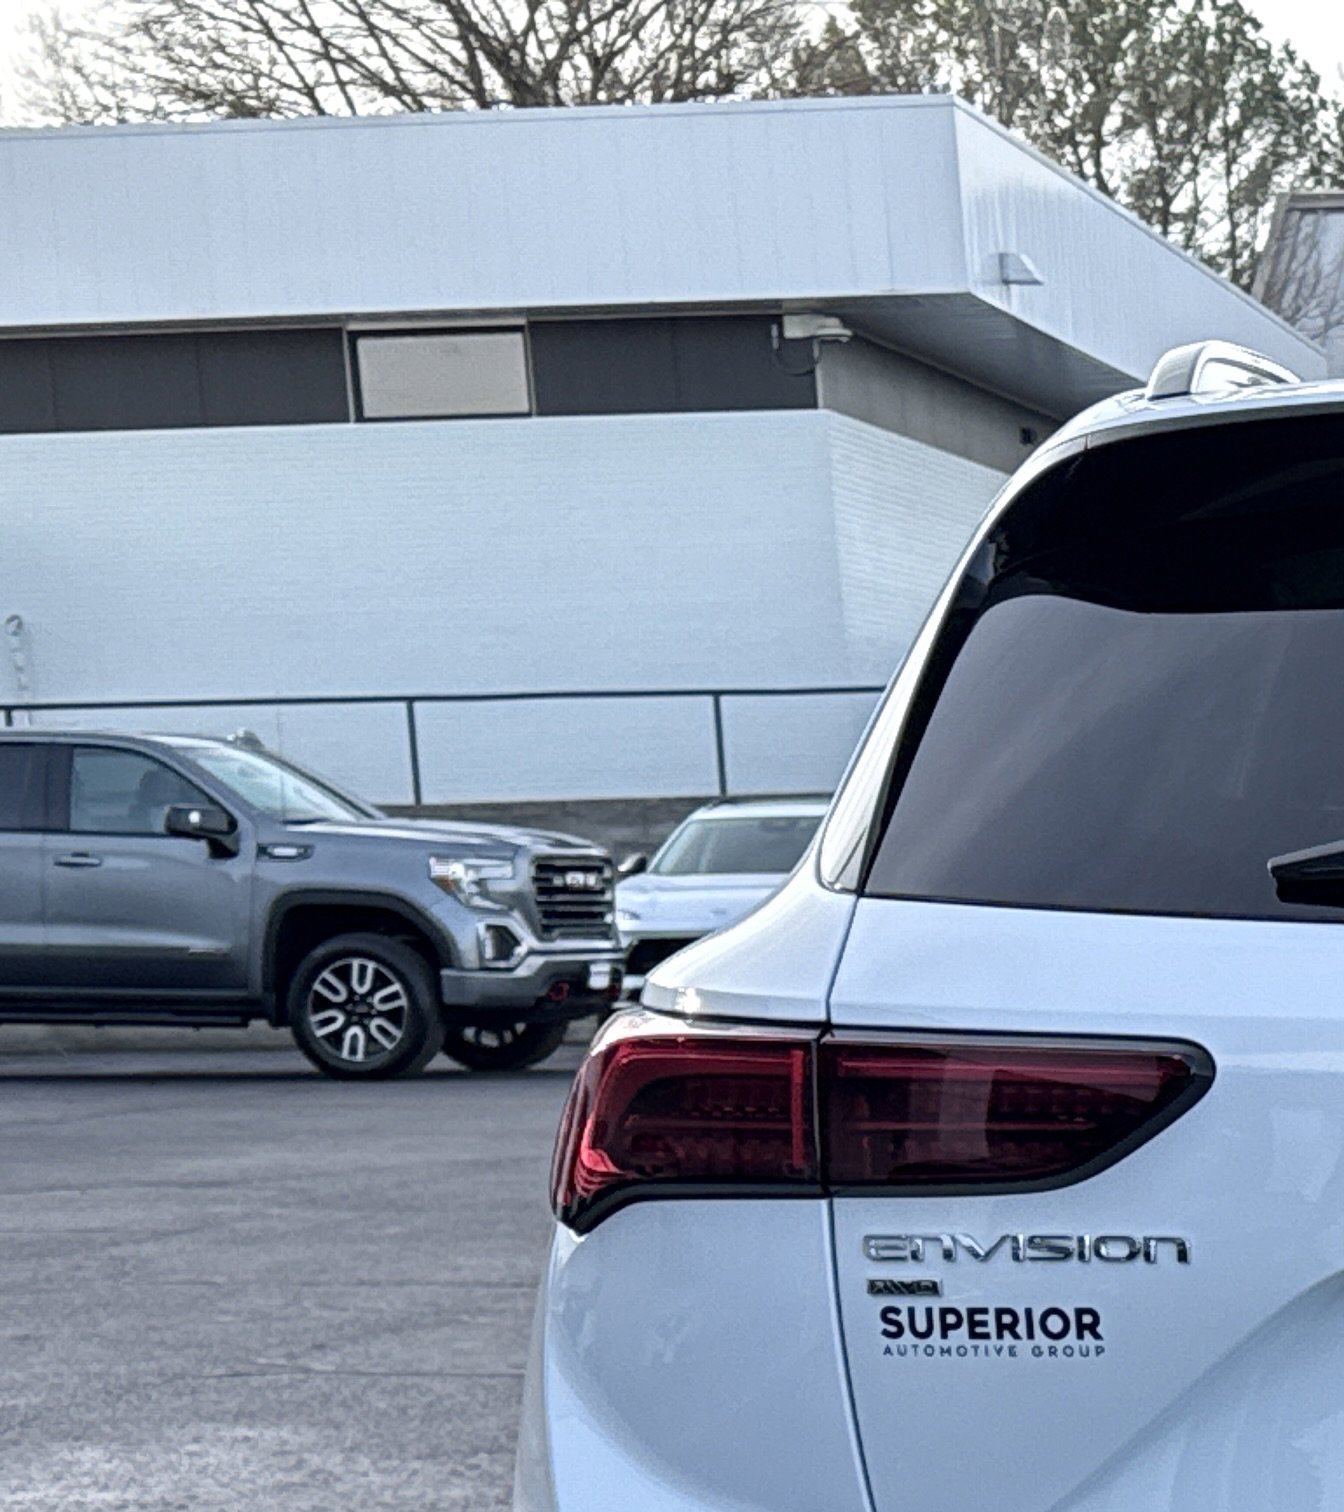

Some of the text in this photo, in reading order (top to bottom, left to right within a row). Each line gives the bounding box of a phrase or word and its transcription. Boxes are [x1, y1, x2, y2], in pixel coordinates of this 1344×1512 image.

[862, 1232, 1192, 1264] ENVISION
[879, 1306, 1104, 1341] SUPERIOR
[882, 1344, 1106, 1358] AUTOMOTIVE GROUP
